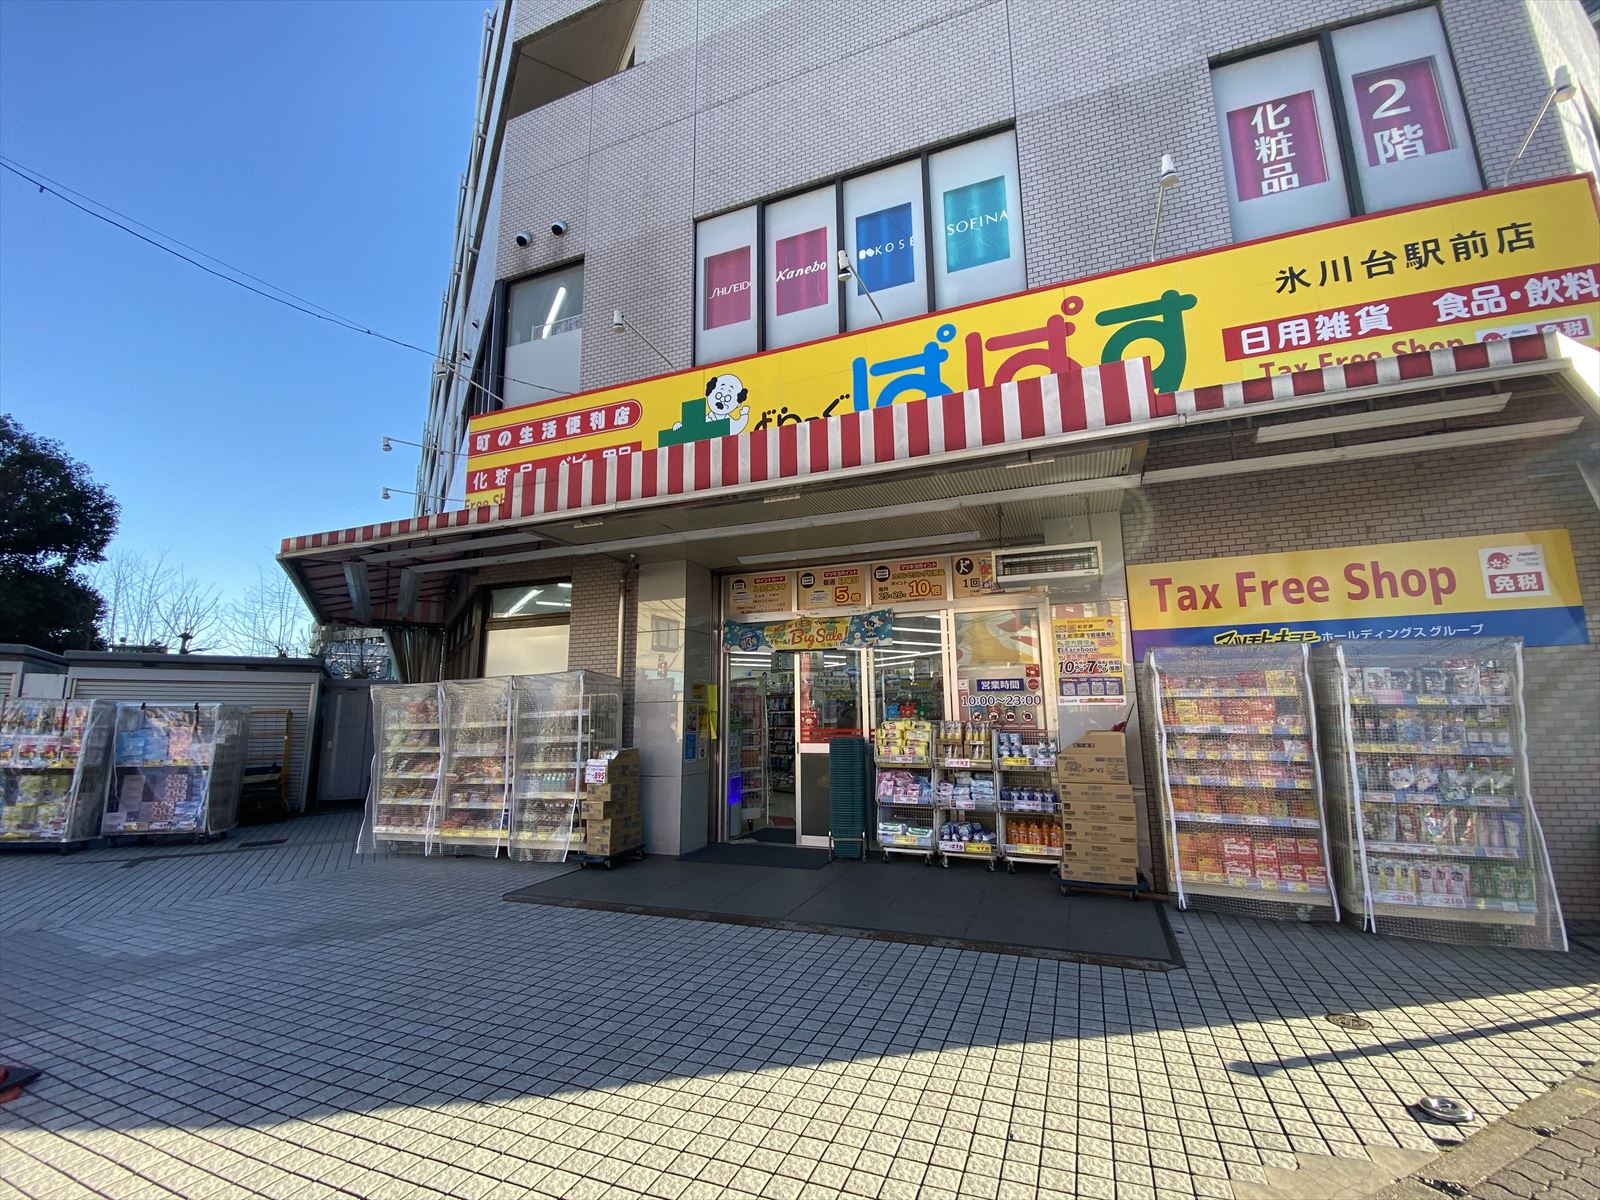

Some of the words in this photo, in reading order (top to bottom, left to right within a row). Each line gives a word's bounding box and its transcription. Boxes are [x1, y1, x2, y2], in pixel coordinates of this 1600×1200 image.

[1368, 78, 1426, 164] 2階
[1251, 103, 1299, 196] 化粧品
[946, 209, 1009, 237] SOFINA
[776, 260, 828, 282] Kanebo
[1275, 221, 1535, 294] 氷川台駅前店
[1240, 303, 1393, 355] 日用雑貨
[1432, 267, 1600, 323] 食品・飲料
[476, 406, 630, 451] 町の生活便利店
[909, 579, 942, 597] 10倍
[1150, 577, 1222, 612] Tax
[1235, 570, 1330, 607] Free
[1345, 560, 1457, 605] Shop
[1494, 573, 1539, 592] 免税
[790, 628, 815, 648] Big
[1321, 625, 1426, 642] ホールディングス
[1430, 623, 1484, 637] グループ
[981, 680, 1020, 690] 営業時間
